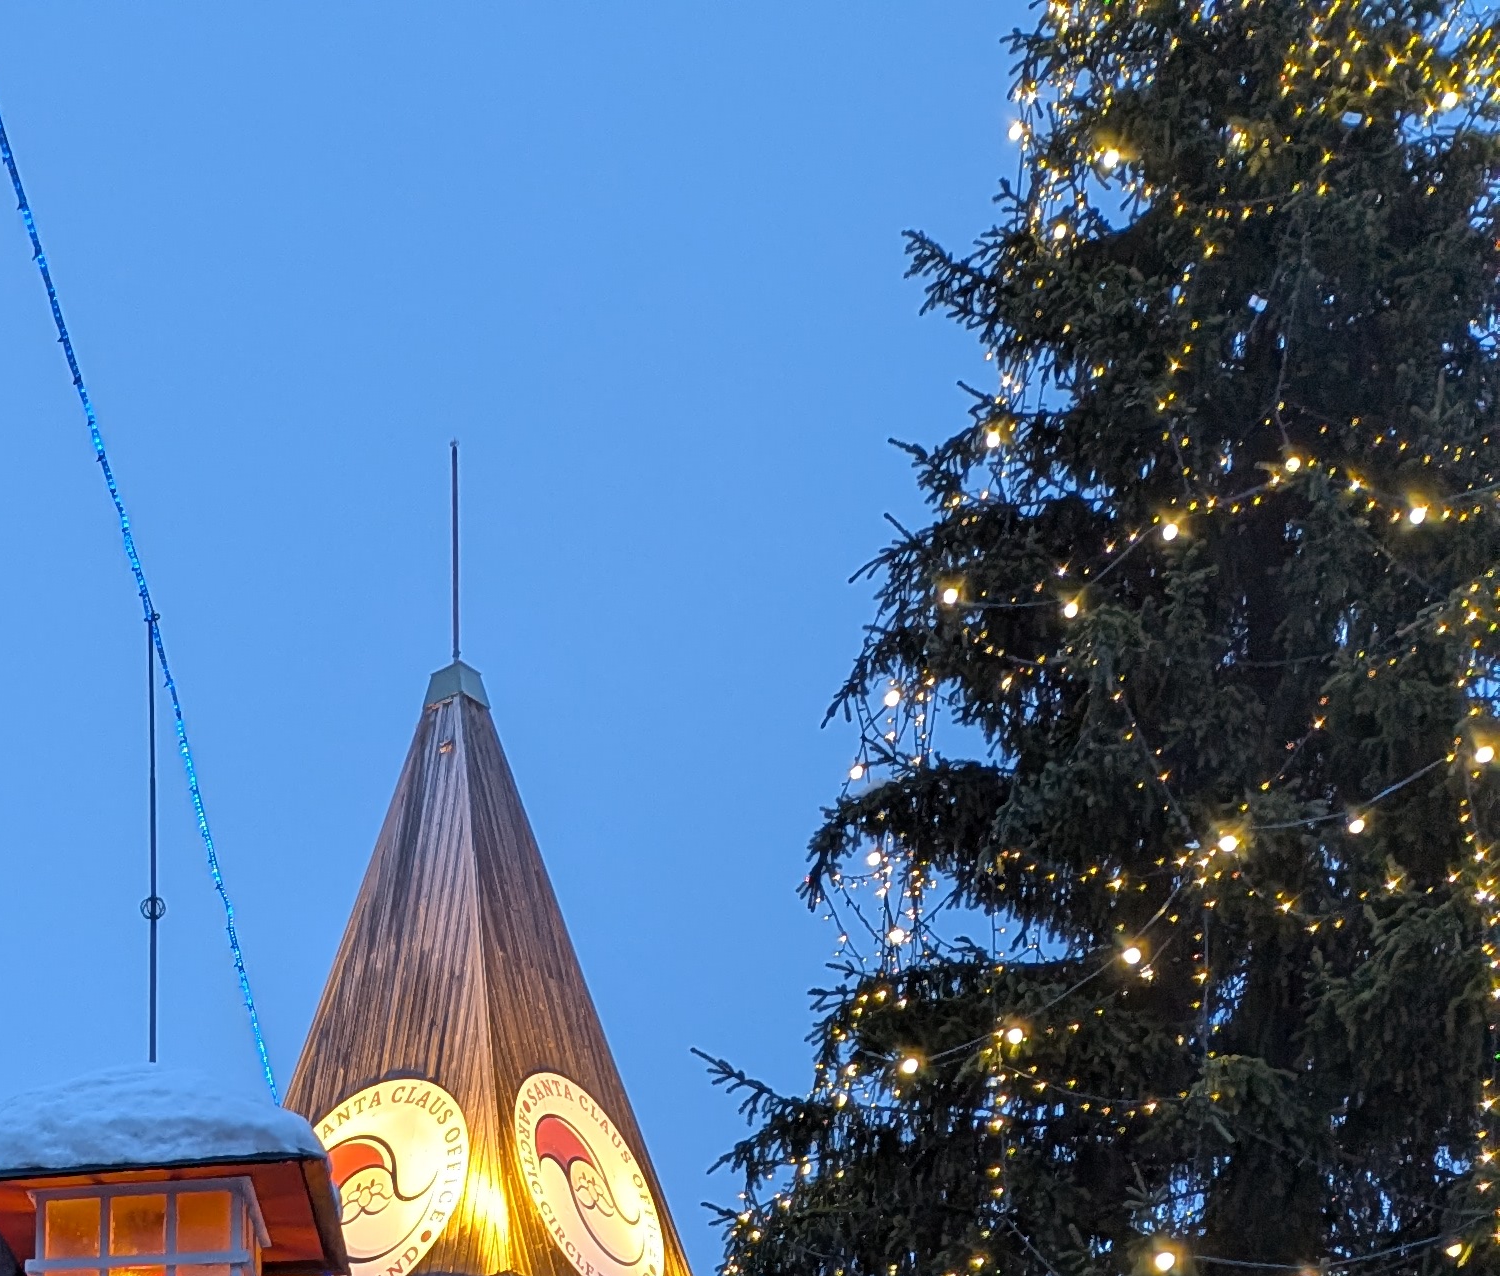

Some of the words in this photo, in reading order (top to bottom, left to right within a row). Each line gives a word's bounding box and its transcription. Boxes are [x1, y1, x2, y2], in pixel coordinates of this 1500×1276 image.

[322, 1090, 382, 1140] ANTA
[391, 1086, 453, 1125] CLAUS
[430, 1126, 462, 1223] OFFICE
[518, 1107, 543, 1195] ARCTIC
[527, 1079, 574, 1107] SANTA
[579, 1094, 631, 1164] CLAUS
